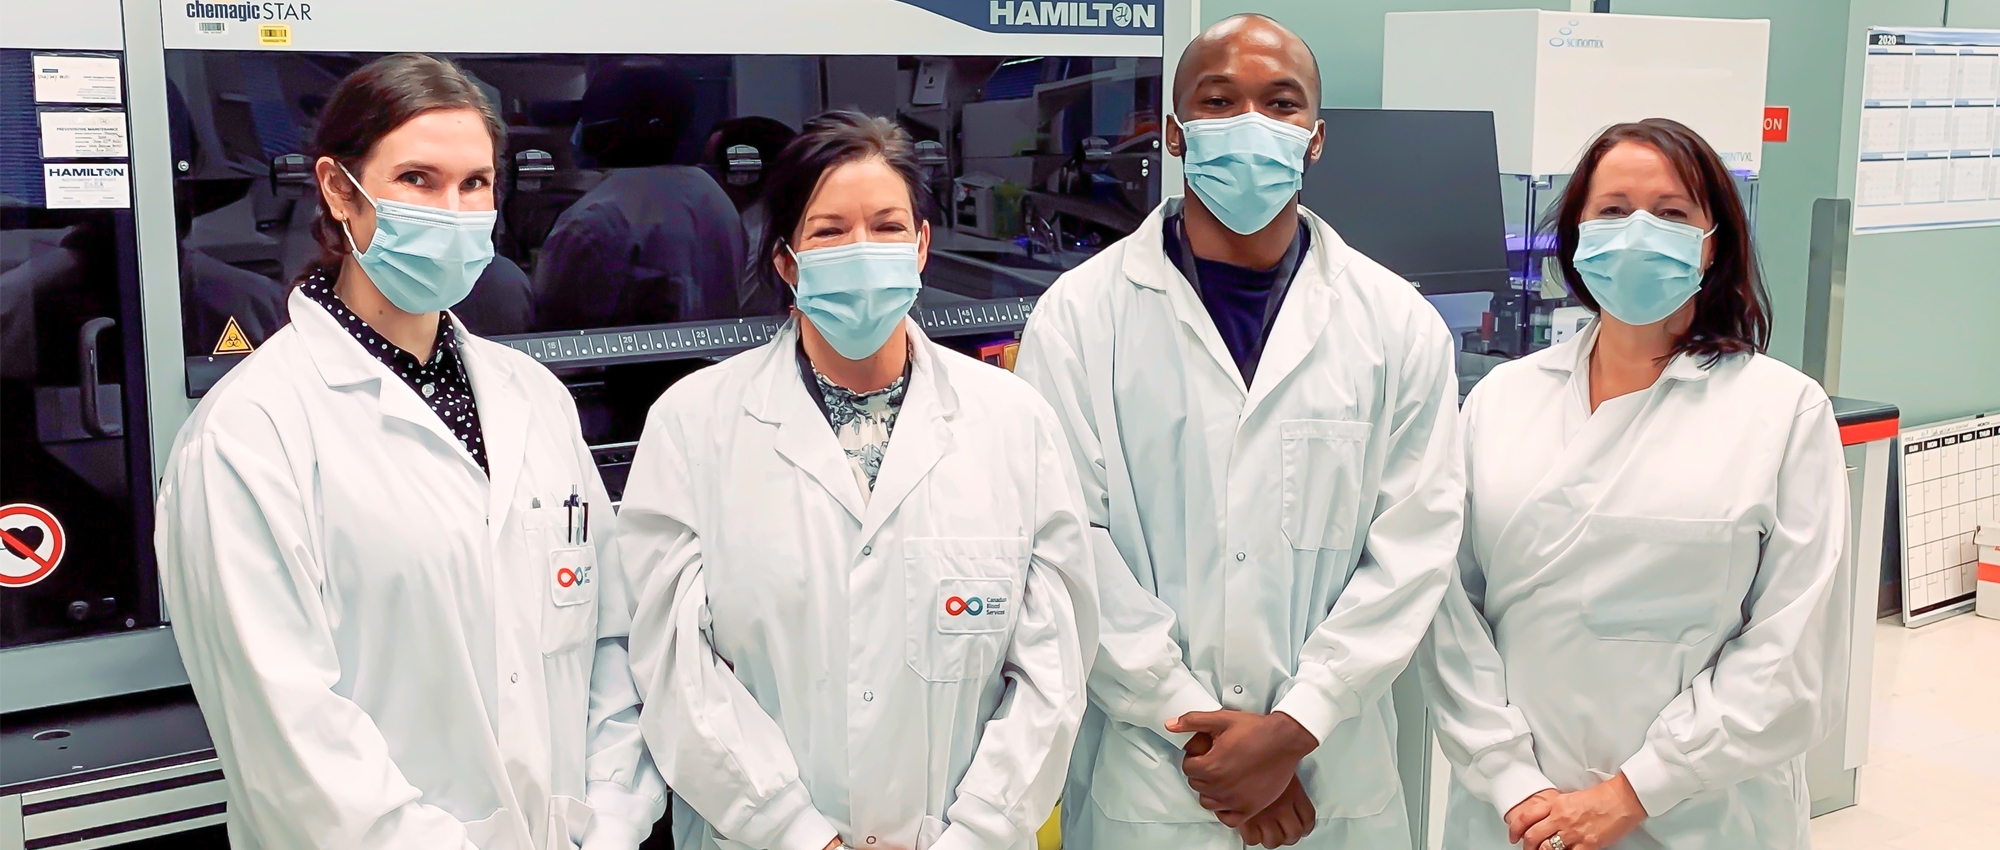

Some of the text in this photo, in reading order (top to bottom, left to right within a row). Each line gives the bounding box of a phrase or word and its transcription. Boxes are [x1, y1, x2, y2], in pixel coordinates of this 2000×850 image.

[186, 0, 312, 21] chemagic STAR
[989, 0, 1156, 28] HAMILTON
[1878, 35, 1897, 45] 2020
[1763, 118, 1783, 131] ON
[49, 168, 124, 177] HAMILTON
